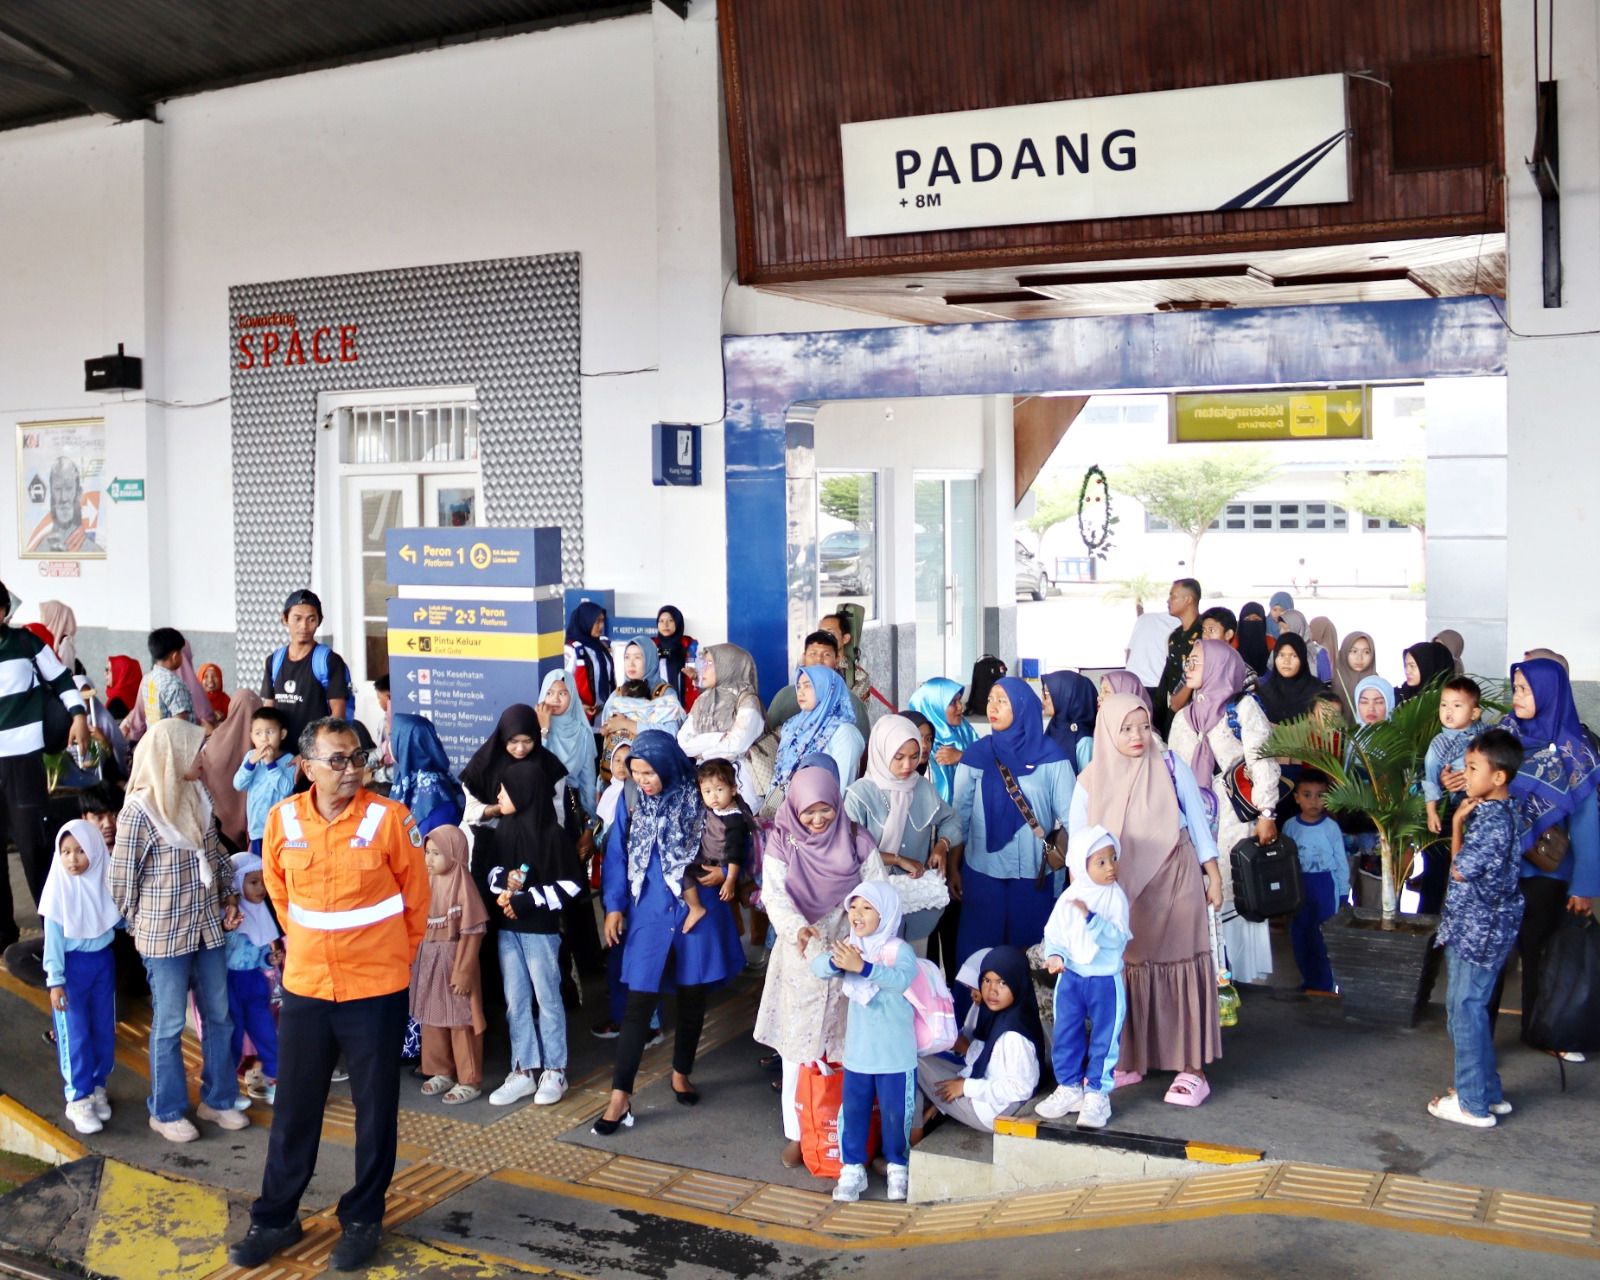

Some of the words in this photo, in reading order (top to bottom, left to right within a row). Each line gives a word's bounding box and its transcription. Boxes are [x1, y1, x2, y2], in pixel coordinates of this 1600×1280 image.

[895, 128, 1137, 189] PADANG
[899, 198, 909, 208] +
[915, 193, 941, 208] 8M
[237, 325, 358, 370] SPACE
[423, 544, 452, 557] Peron
[456, 547, 465, 565] 1
[480, 606, 505, 618] Peron
[434, 636, 454, 645] Pintu
[456, 636, 481, 646] Keluar
[432, 668, 445, 678] Pos
[446, 669, 484, 679] Kesehatan
[433, 689, 451, 698] Area
[452, 690, 484, 700] Merokok
[434, 710, 456, 721] Ruang
[458, 711, 494, 722] Menyusui
[460, 735, 479, 746] Kerja
